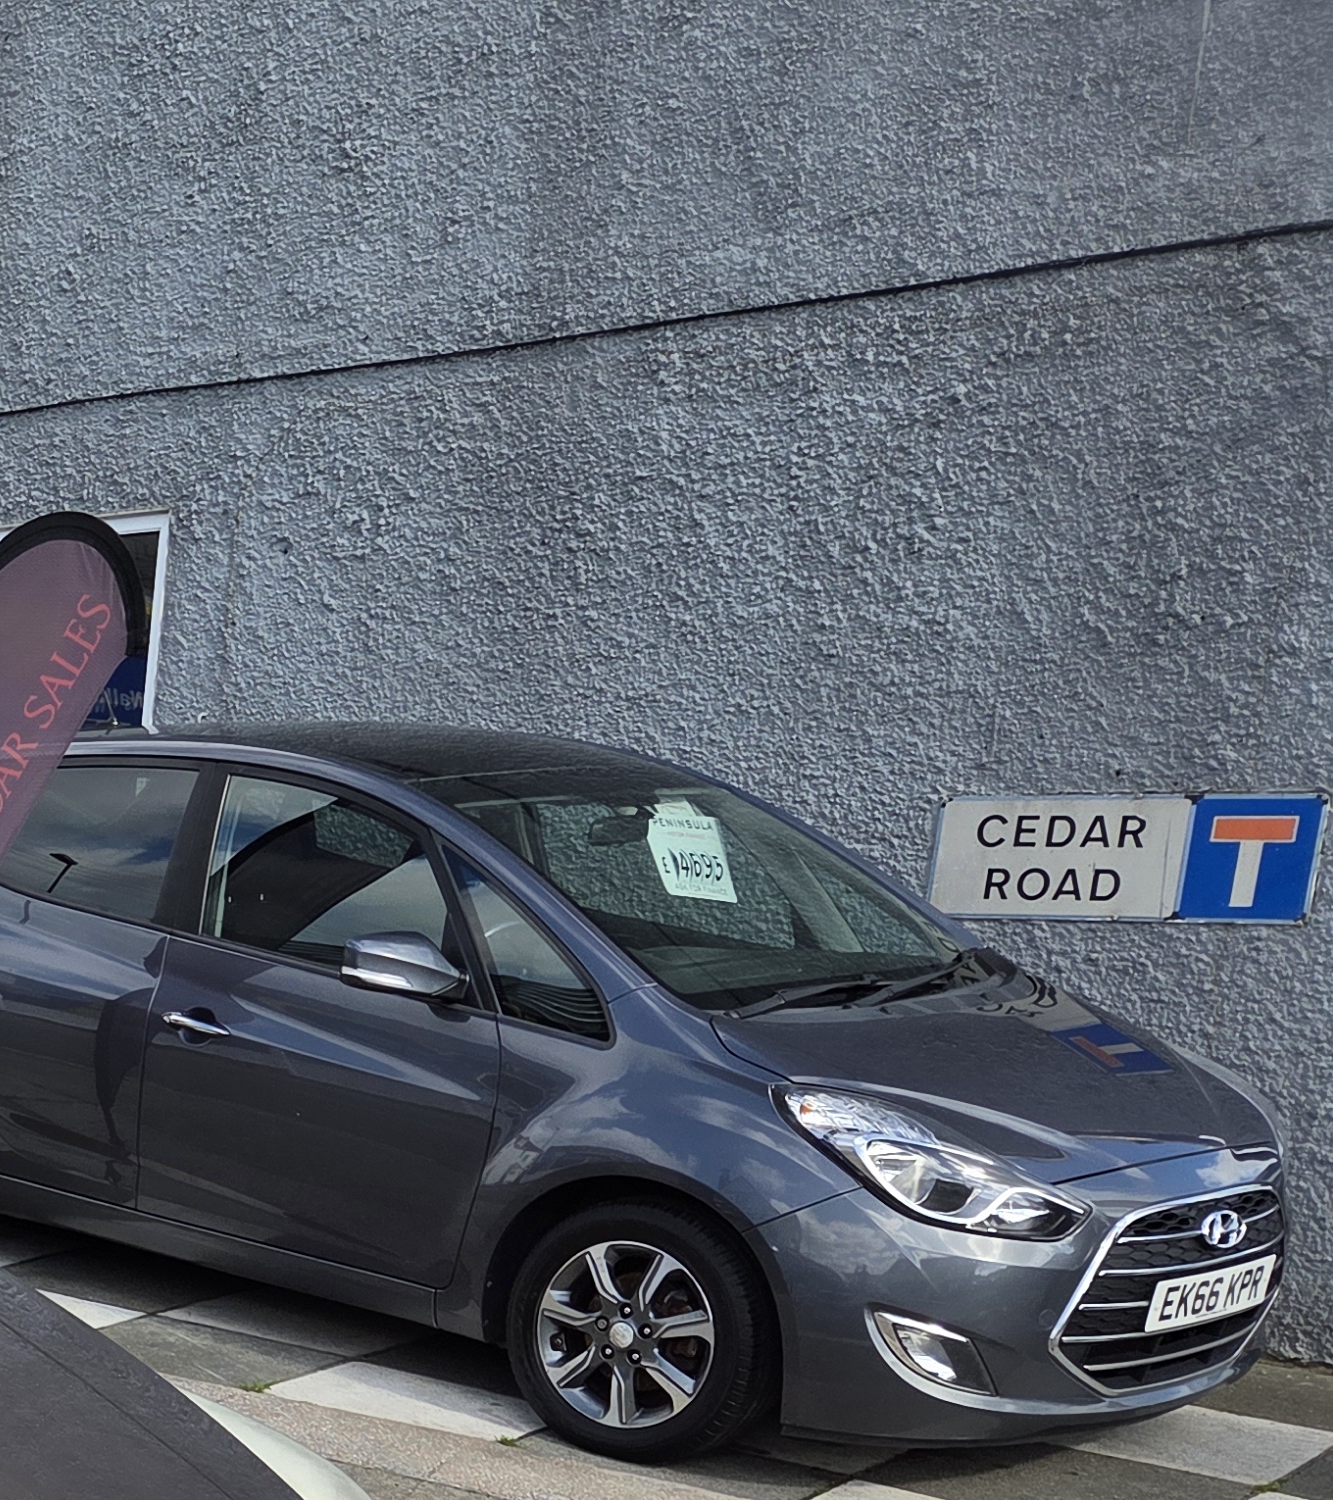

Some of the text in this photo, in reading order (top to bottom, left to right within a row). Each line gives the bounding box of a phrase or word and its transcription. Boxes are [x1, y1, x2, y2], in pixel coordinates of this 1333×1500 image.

[22, 593, 111, 730] SALES
[652, 817, 714, 831] PENINSULA
[976, 814, 1147, 849] CEDAR
[983, 867, 1121, 902] ROAD
[1158, 1265, 1265, 1322] EK66 KPR
